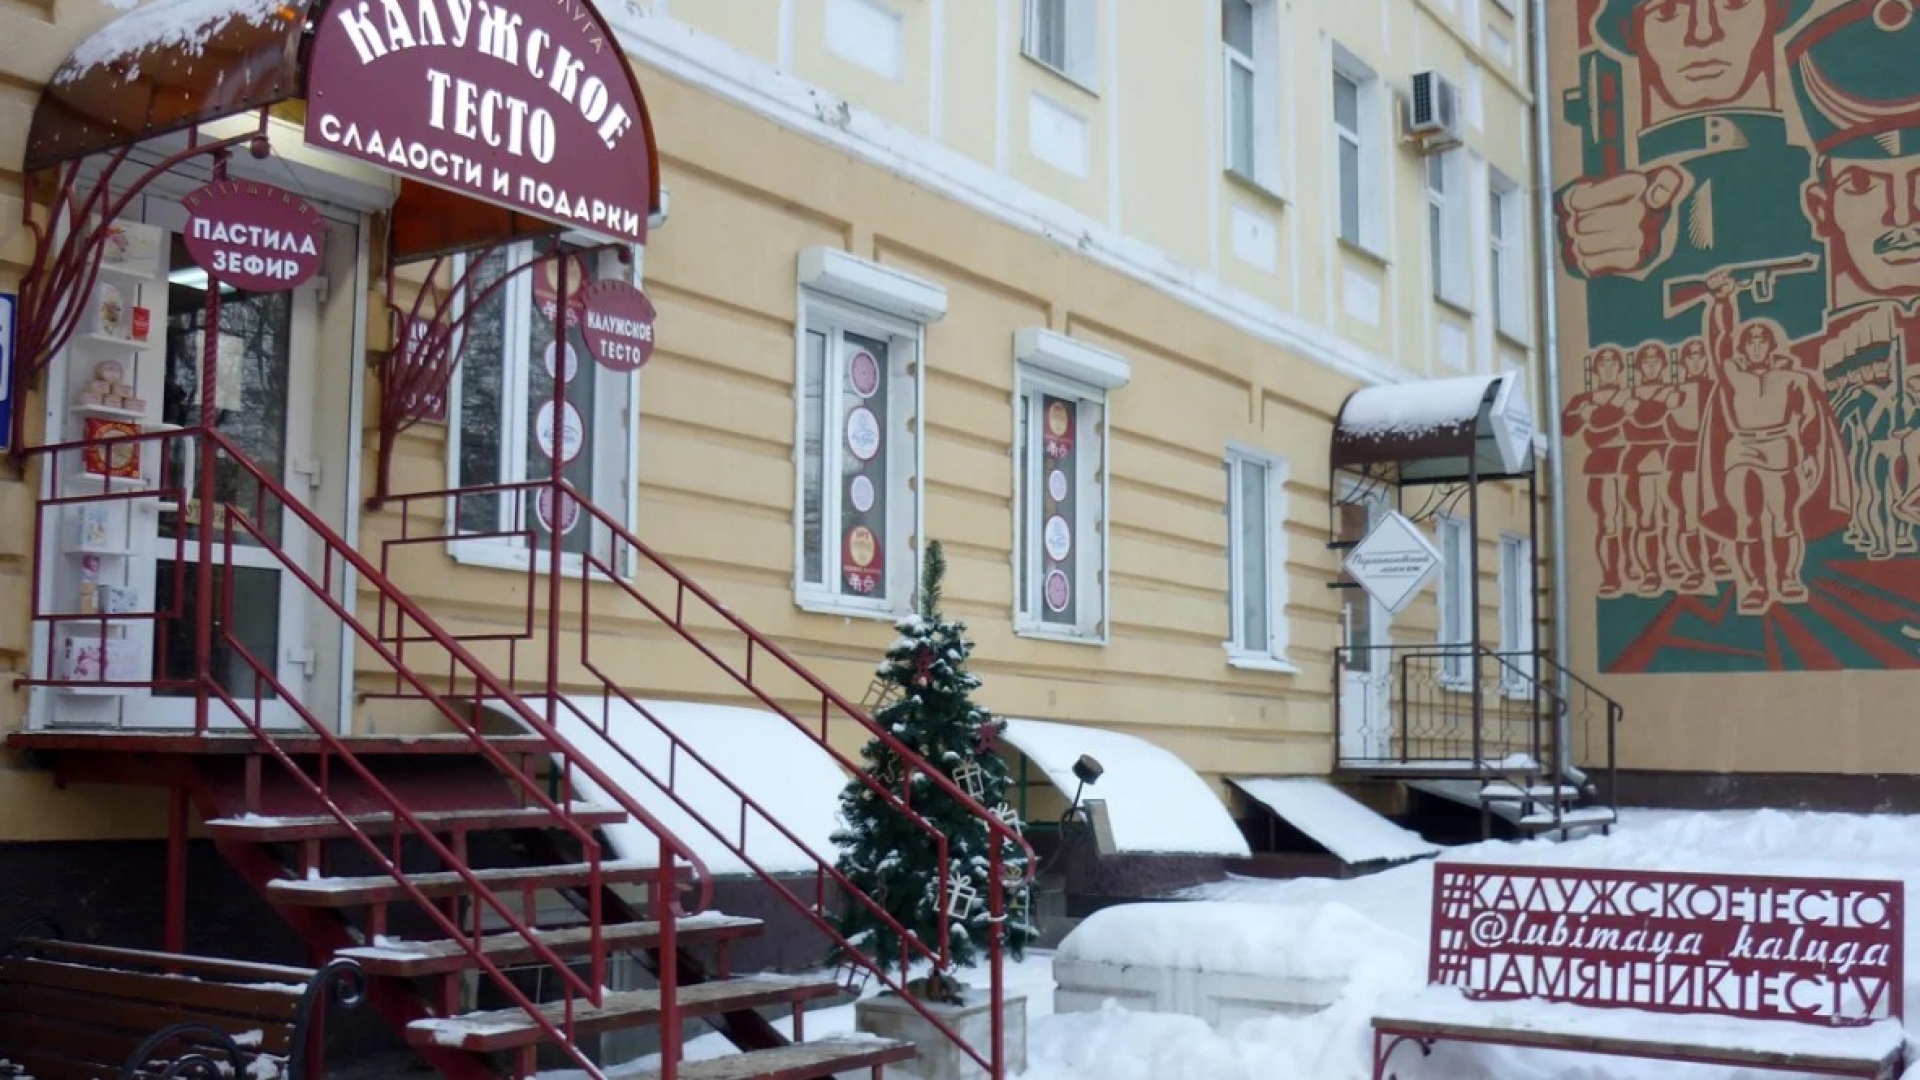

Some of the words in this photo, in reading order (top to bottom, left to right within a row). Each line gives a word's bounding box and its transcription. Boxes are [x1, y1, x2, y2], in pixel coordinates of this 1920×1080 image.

[338, 0, 632, 149] КАЛУЖСКОЕ
[427, 68, 556, 164] ТЕСТО
[319, 114, 482, 187] СЛАДОСТИ
[491, 167, 510, 196] И
[519, 176, 638, 236] ПОДАРКИ
[193, 217, 318, 256] ПАСТИЛА
[212, 249, 300, 280] ЗЕФИР
[587, 310, 652, 341] КАЛУЖСКОЕ
[600, 338, 641, 365] ТЕСТО
[1440, 872, 1891, 930] #КАЛУЖСКОЕТЕСТО
